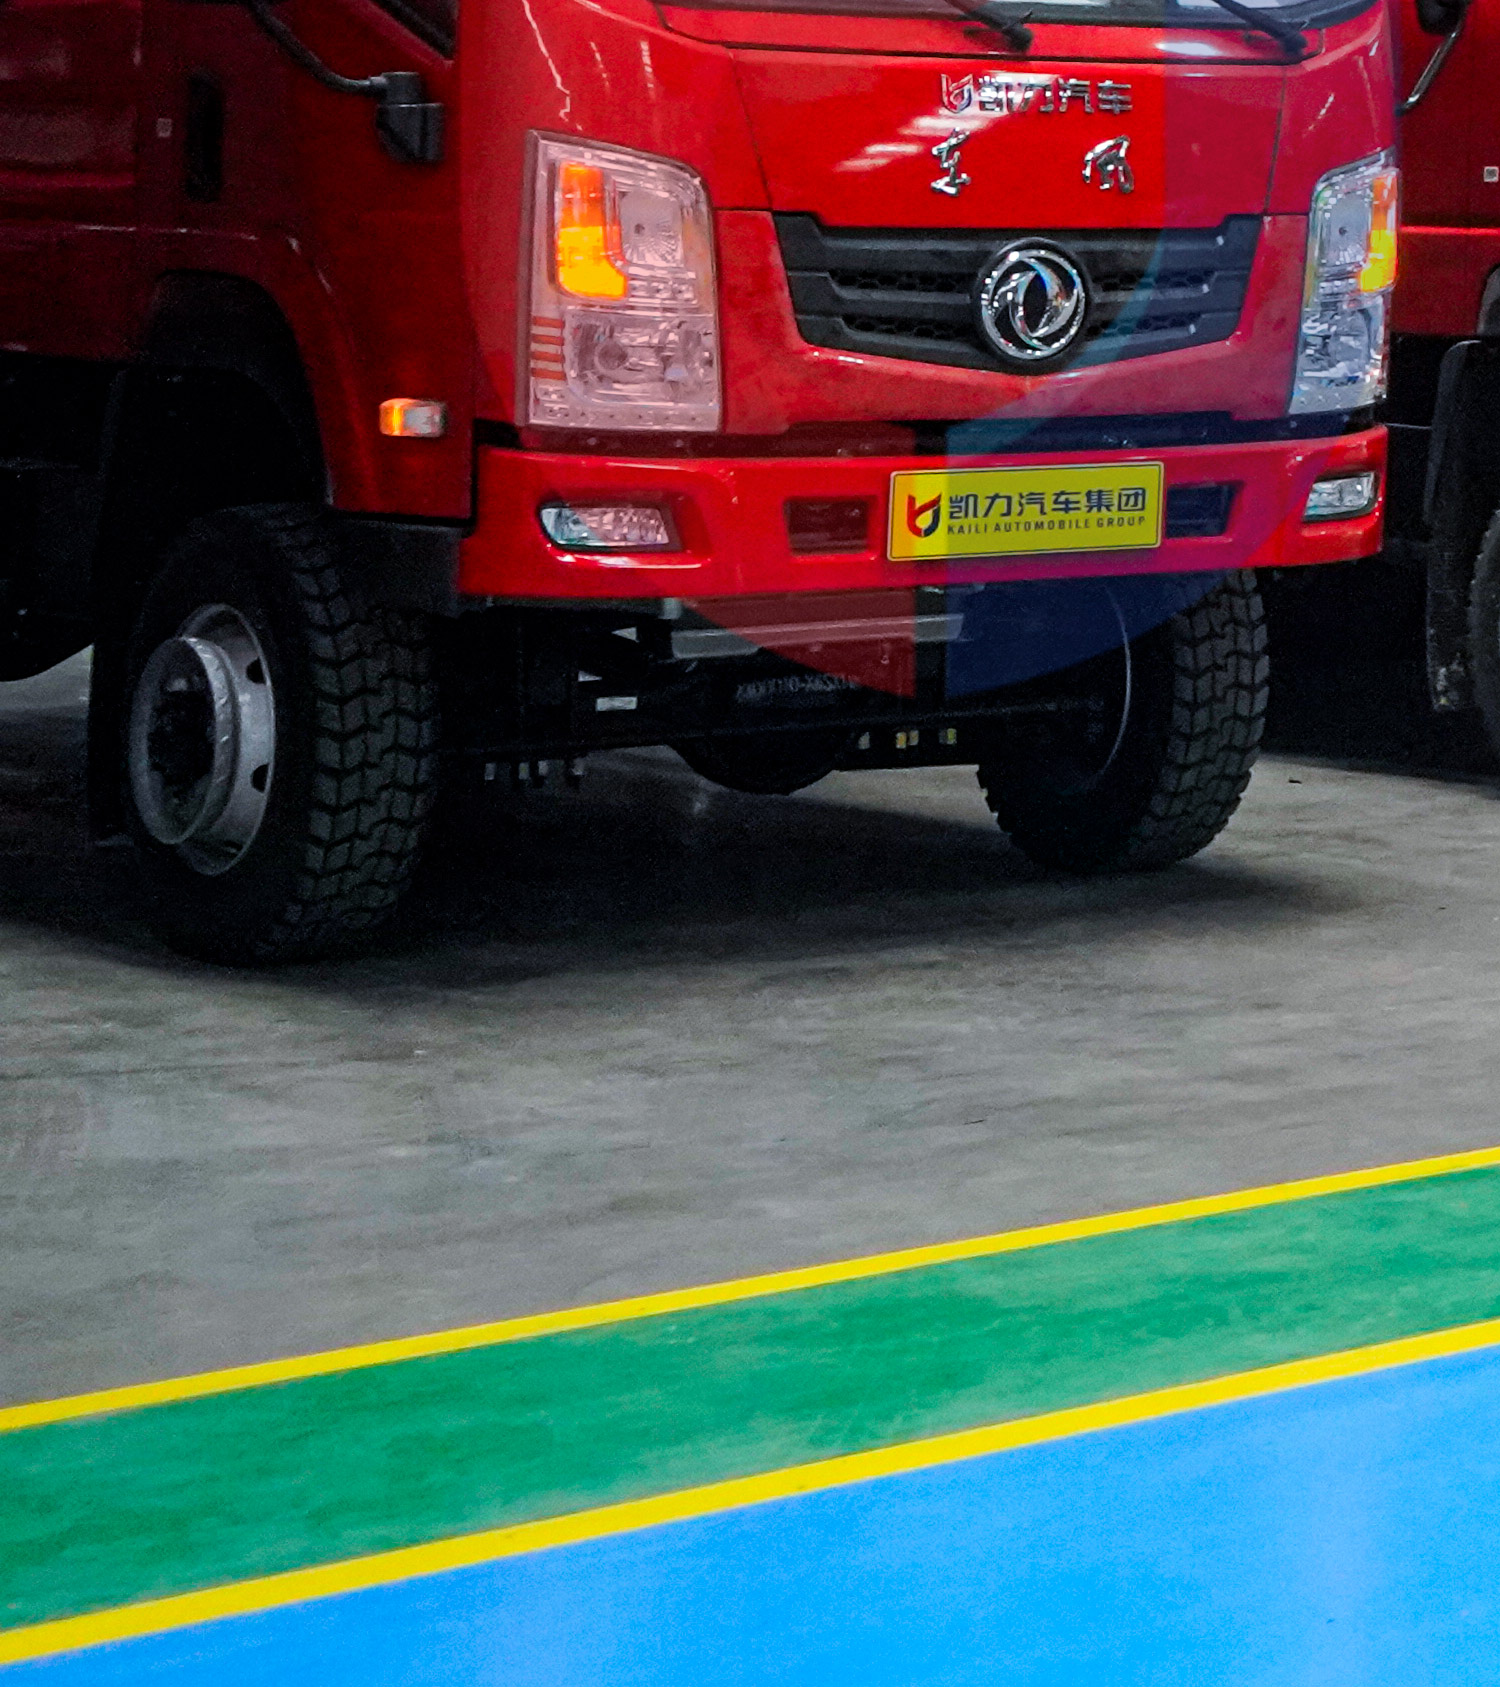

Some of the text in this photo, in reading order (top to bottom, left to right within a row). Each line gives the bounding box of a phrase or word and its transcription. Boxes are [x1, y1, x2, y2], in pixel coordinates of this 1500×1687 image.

[949, 486, 1146, 520] 凯力汽车集团
[947, 515, 1147, 536] KAILI AUTOMOBILE GROUP
